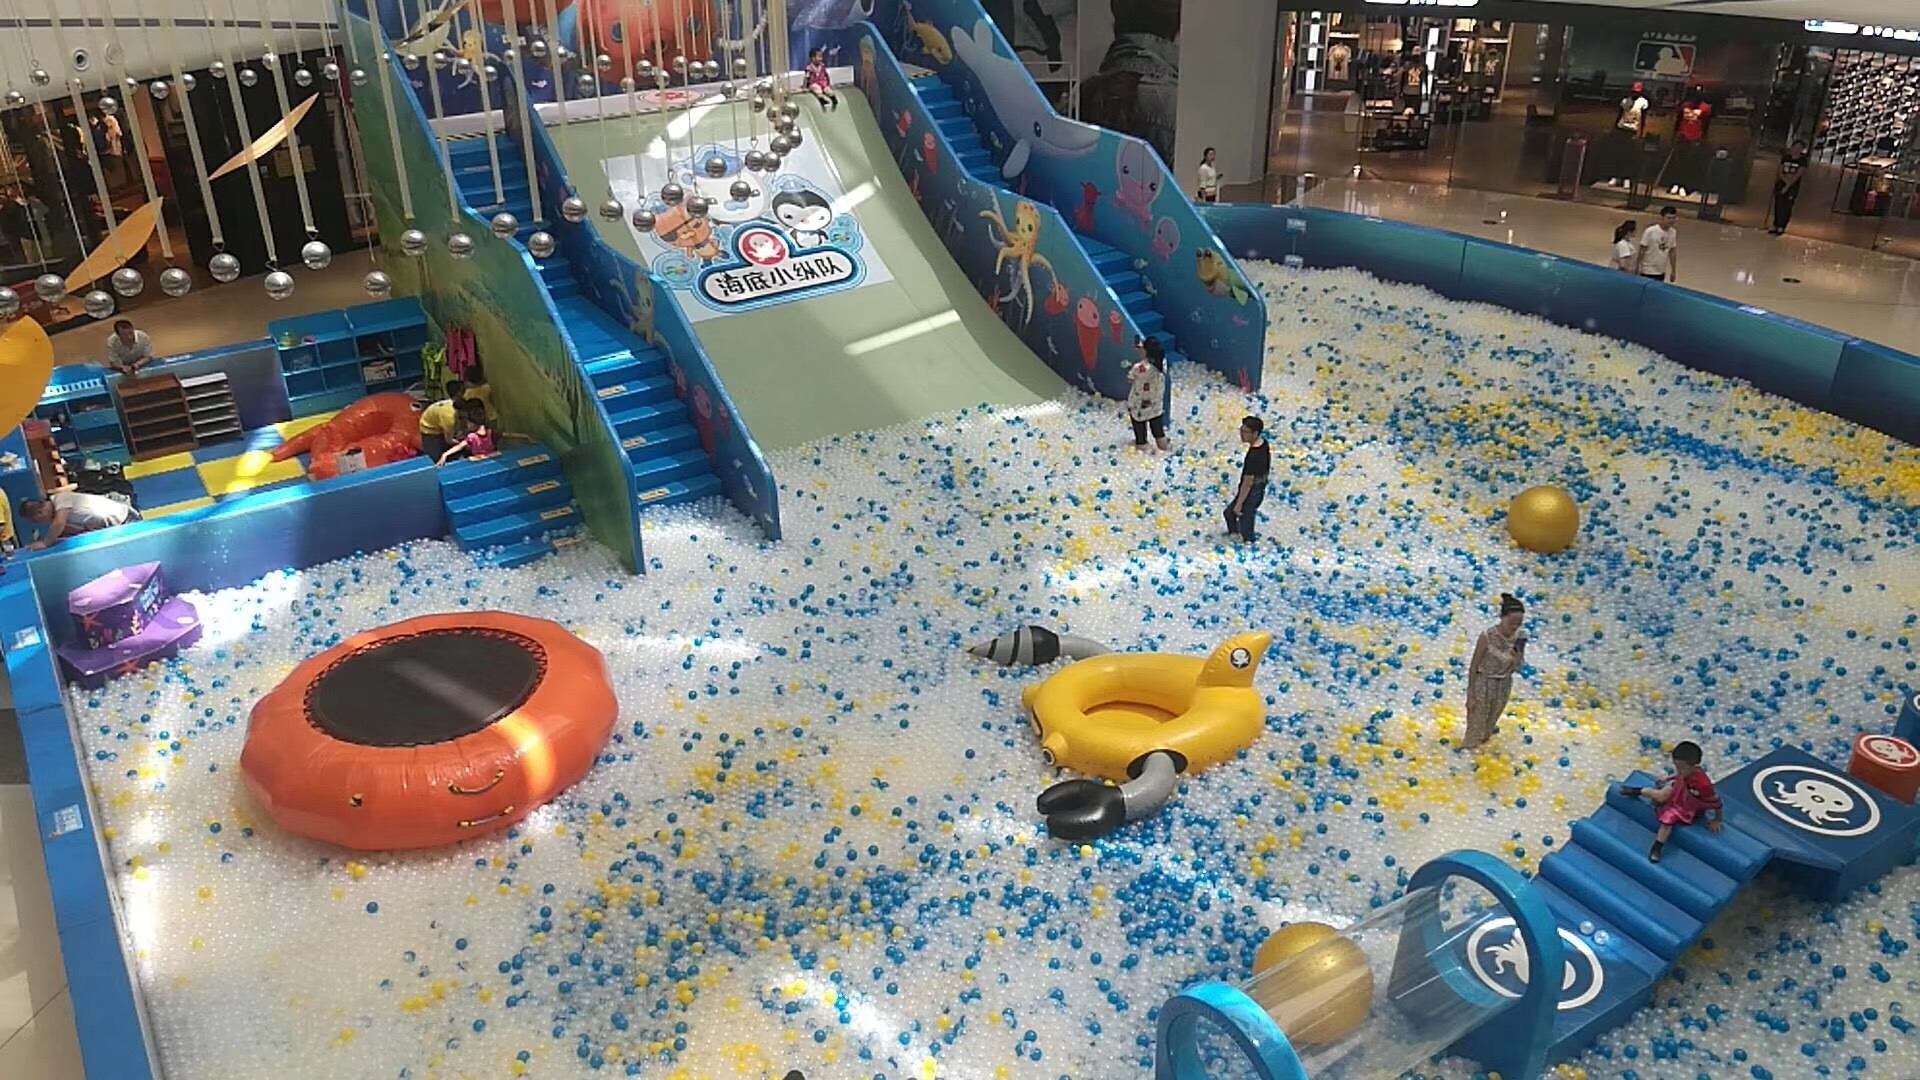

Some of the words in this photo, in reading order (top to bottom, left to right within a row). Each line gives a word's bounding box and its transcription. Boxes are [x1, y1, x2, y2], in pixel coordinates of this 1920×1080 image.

[715, 256, 843, 297] 海底小纵队
